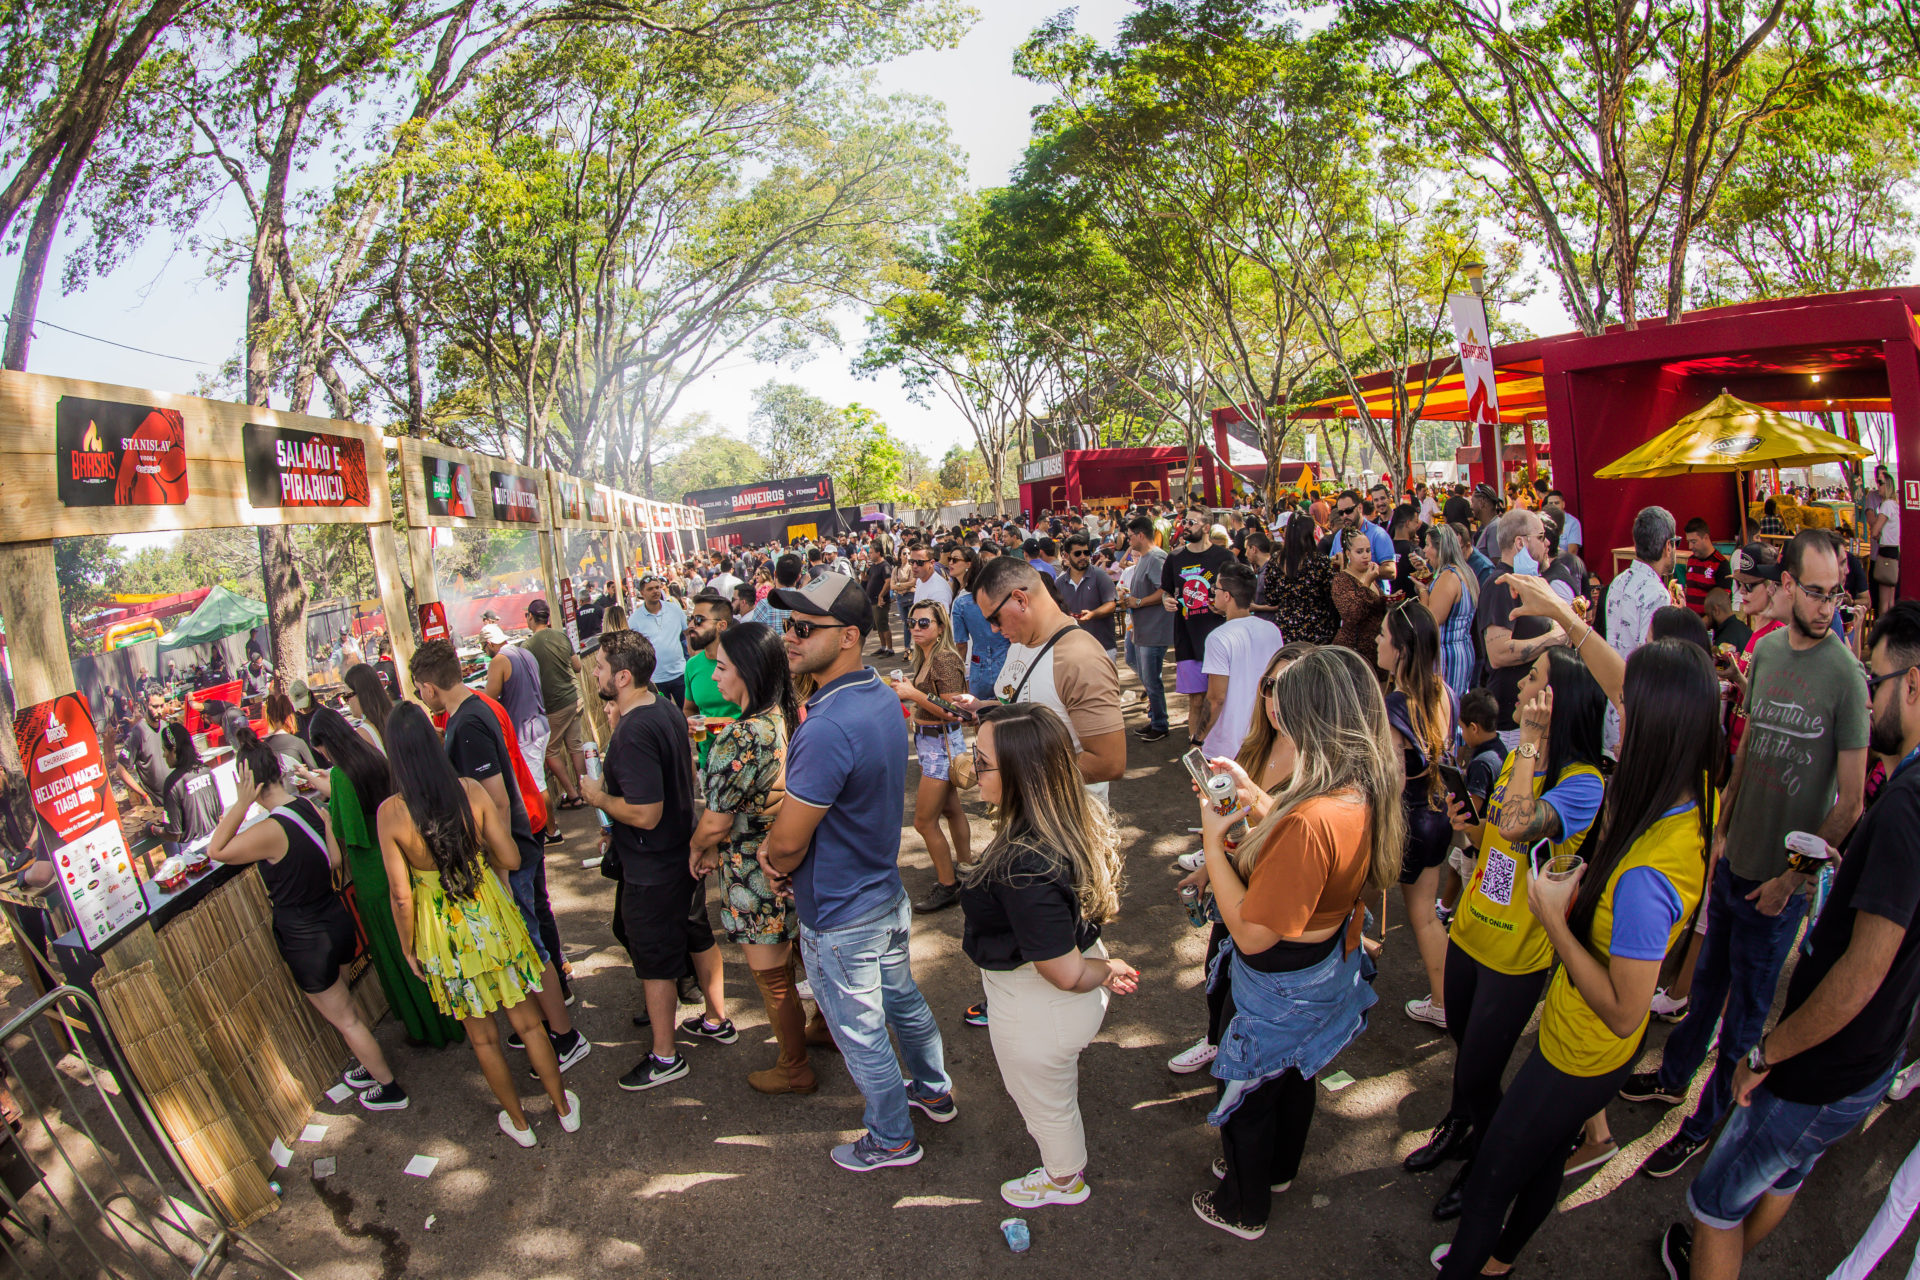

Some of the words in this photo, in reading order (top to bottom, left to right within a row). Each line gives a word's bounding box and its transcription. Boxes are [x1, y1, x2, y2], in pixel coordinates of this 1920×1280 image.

[121, 438, 171, 452] STANISLAV
[276, 437, 331, 470] SALMÃO
[332, 446, 342, 471] E
[71, 450, 116, 480] BRASAS
[280, 472, 344, 500] PIRARUCU
[731, 489, 785, 507] BANHEIROS
[580, 607, 595, 616] STAFF
[34, 776, 74, 805] HELVECIO
[186, 773, 212, 795] STAFF
[53, 793, 79, 816] TIAGO
[1489, 918, 1514, 931] ONLINE
